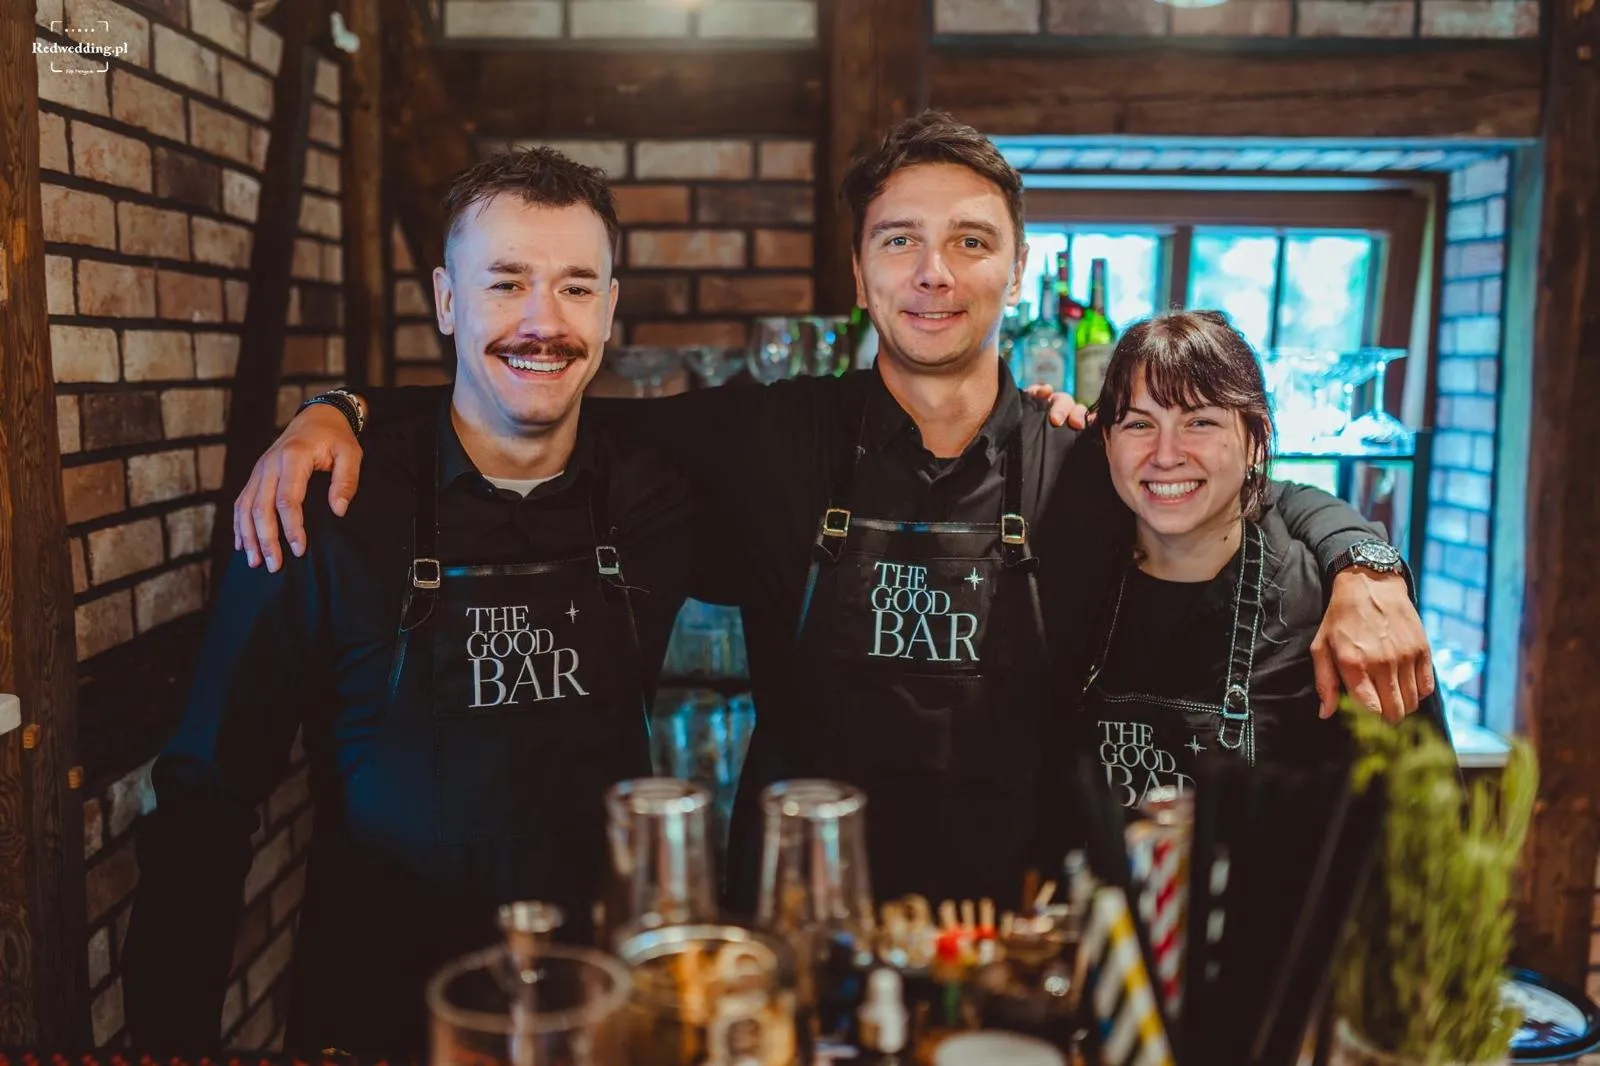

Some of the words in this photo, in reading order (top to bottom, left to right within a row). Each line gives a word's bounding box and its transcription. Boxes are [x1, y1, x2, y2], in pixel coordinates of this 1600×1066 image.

[874, 561, 928, 591] THE
[871, 586, 951, 616] GOOD
[466, 605, 530, 634] THE
[466, 628, 554, 659] GOOD
[868, 608, 980, 662] BAR
[467, 647, 590, 708] BAR
[1097, 720, 1155, 749] THE
[1099, 741, 1177, 773] GOOD
